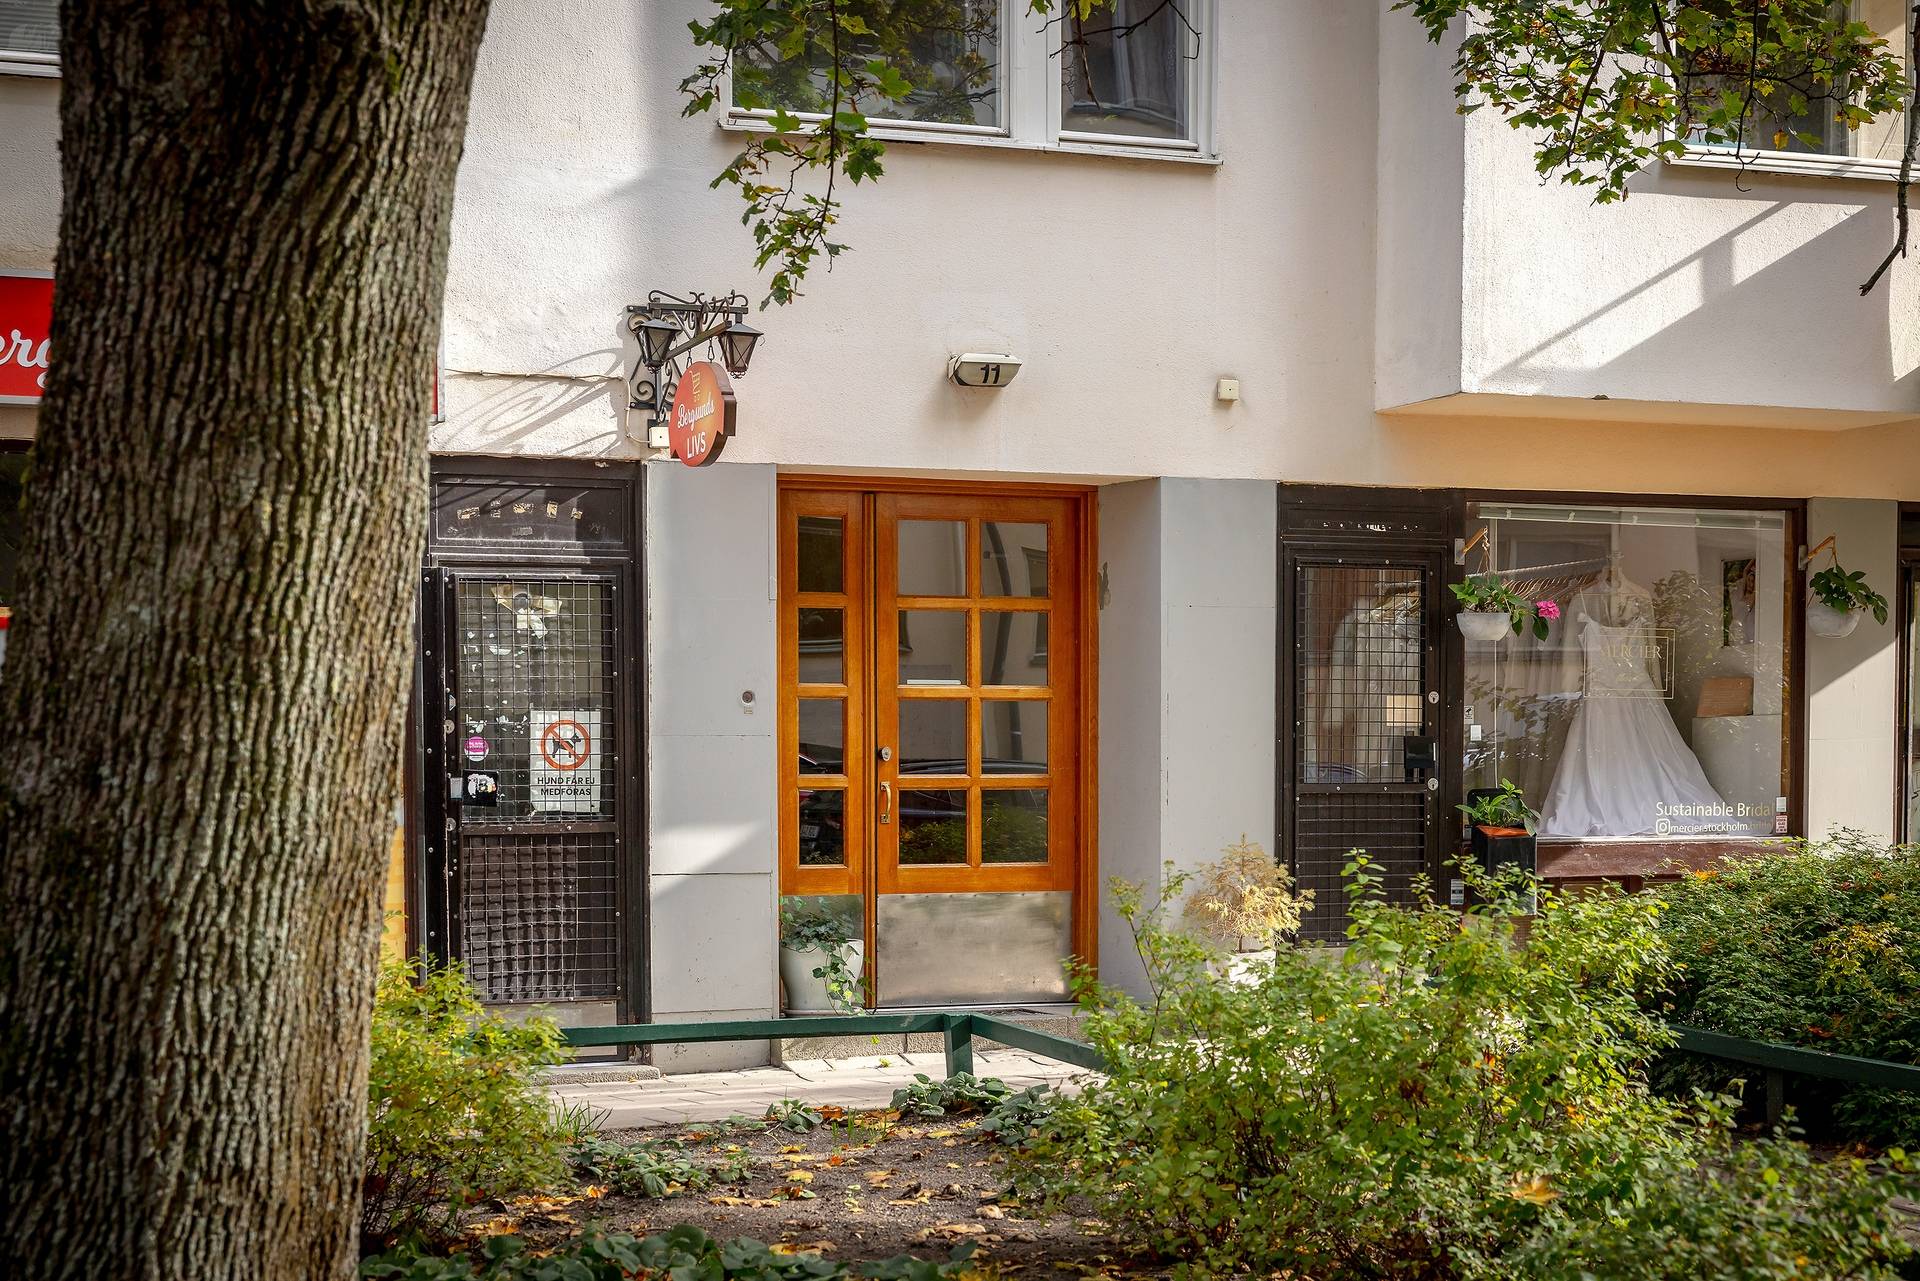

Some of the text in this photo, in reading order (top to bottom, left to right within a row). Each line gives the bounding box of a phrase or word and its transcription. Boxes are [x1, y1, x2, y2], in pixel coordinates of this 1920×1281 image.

[980, 363, 1001, 384] 11
[677, 392, 715, 431] Bergsunds
[687, 431, 706, 459] LIVS
[537, 777, 564, 785] HUND
[585, 777, 595, 785] EJ
[540, 786, 591, 796] MEDFÖRAS
[1656, 801, 1775, 817] Sustainable Bridal
